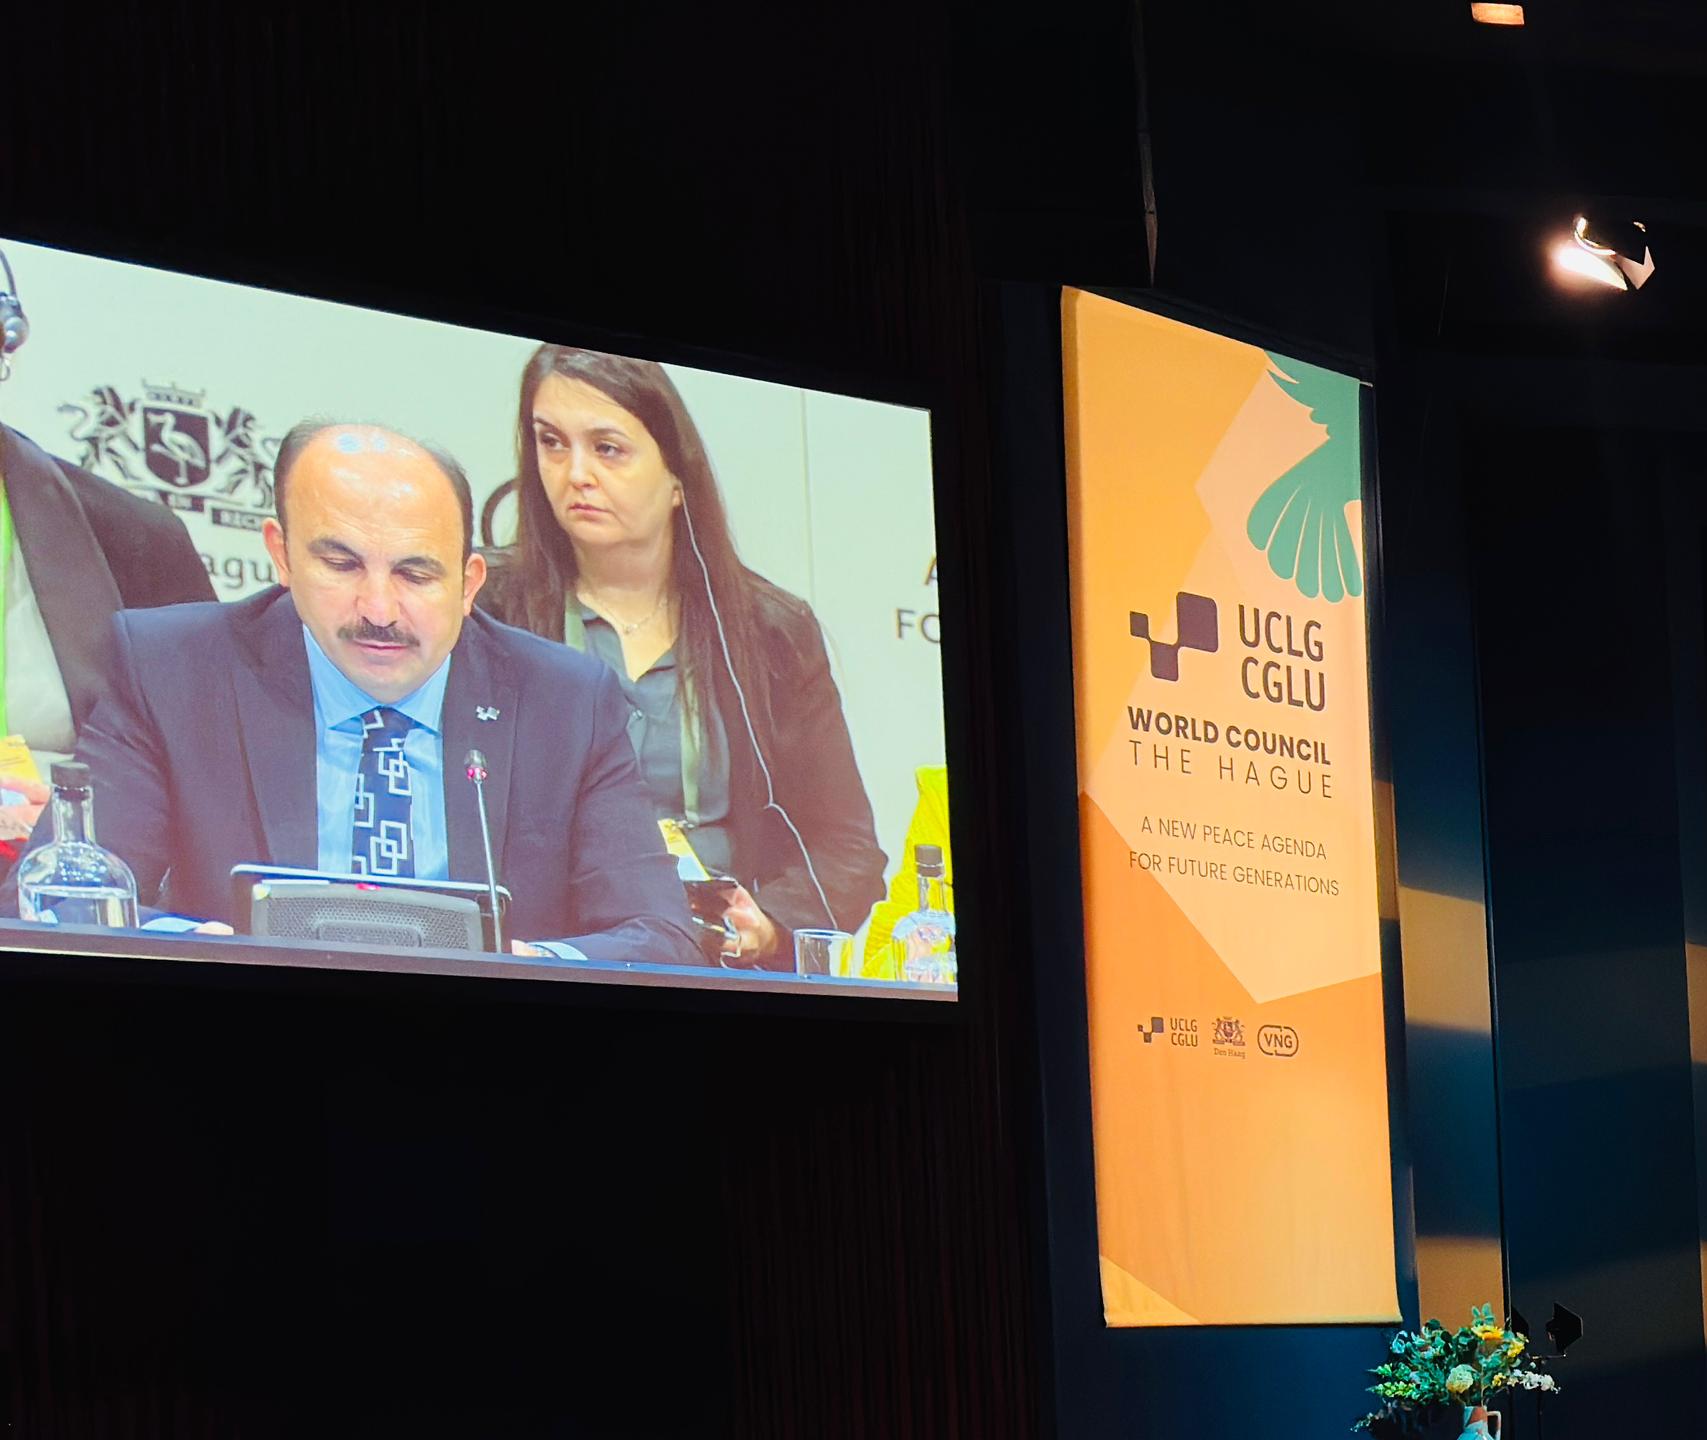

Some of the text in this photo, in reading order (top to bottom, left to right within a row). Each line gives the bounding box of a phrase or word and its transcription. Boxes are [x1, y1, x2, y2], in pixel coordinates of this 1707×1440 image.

[1238, 604, 1324, 662] UCLG
[1241, 657, 1325, 711] CGLU
[1127, 706, 1331, 765] WORLD COUNCIL
[1129, 740, 1332, 798] THE HAGUE
[1141, 816, 1326, 859] A NEW PEACE AGENDA
[1129, 851, 1339, 896] FOR FUTURE GENERATIONS
[1170, 1018, 1198, 1032] UCLG
[1171, 1033, 1198, 1047] CGLU
[1264, 1033, 1293, 1049] VNG
